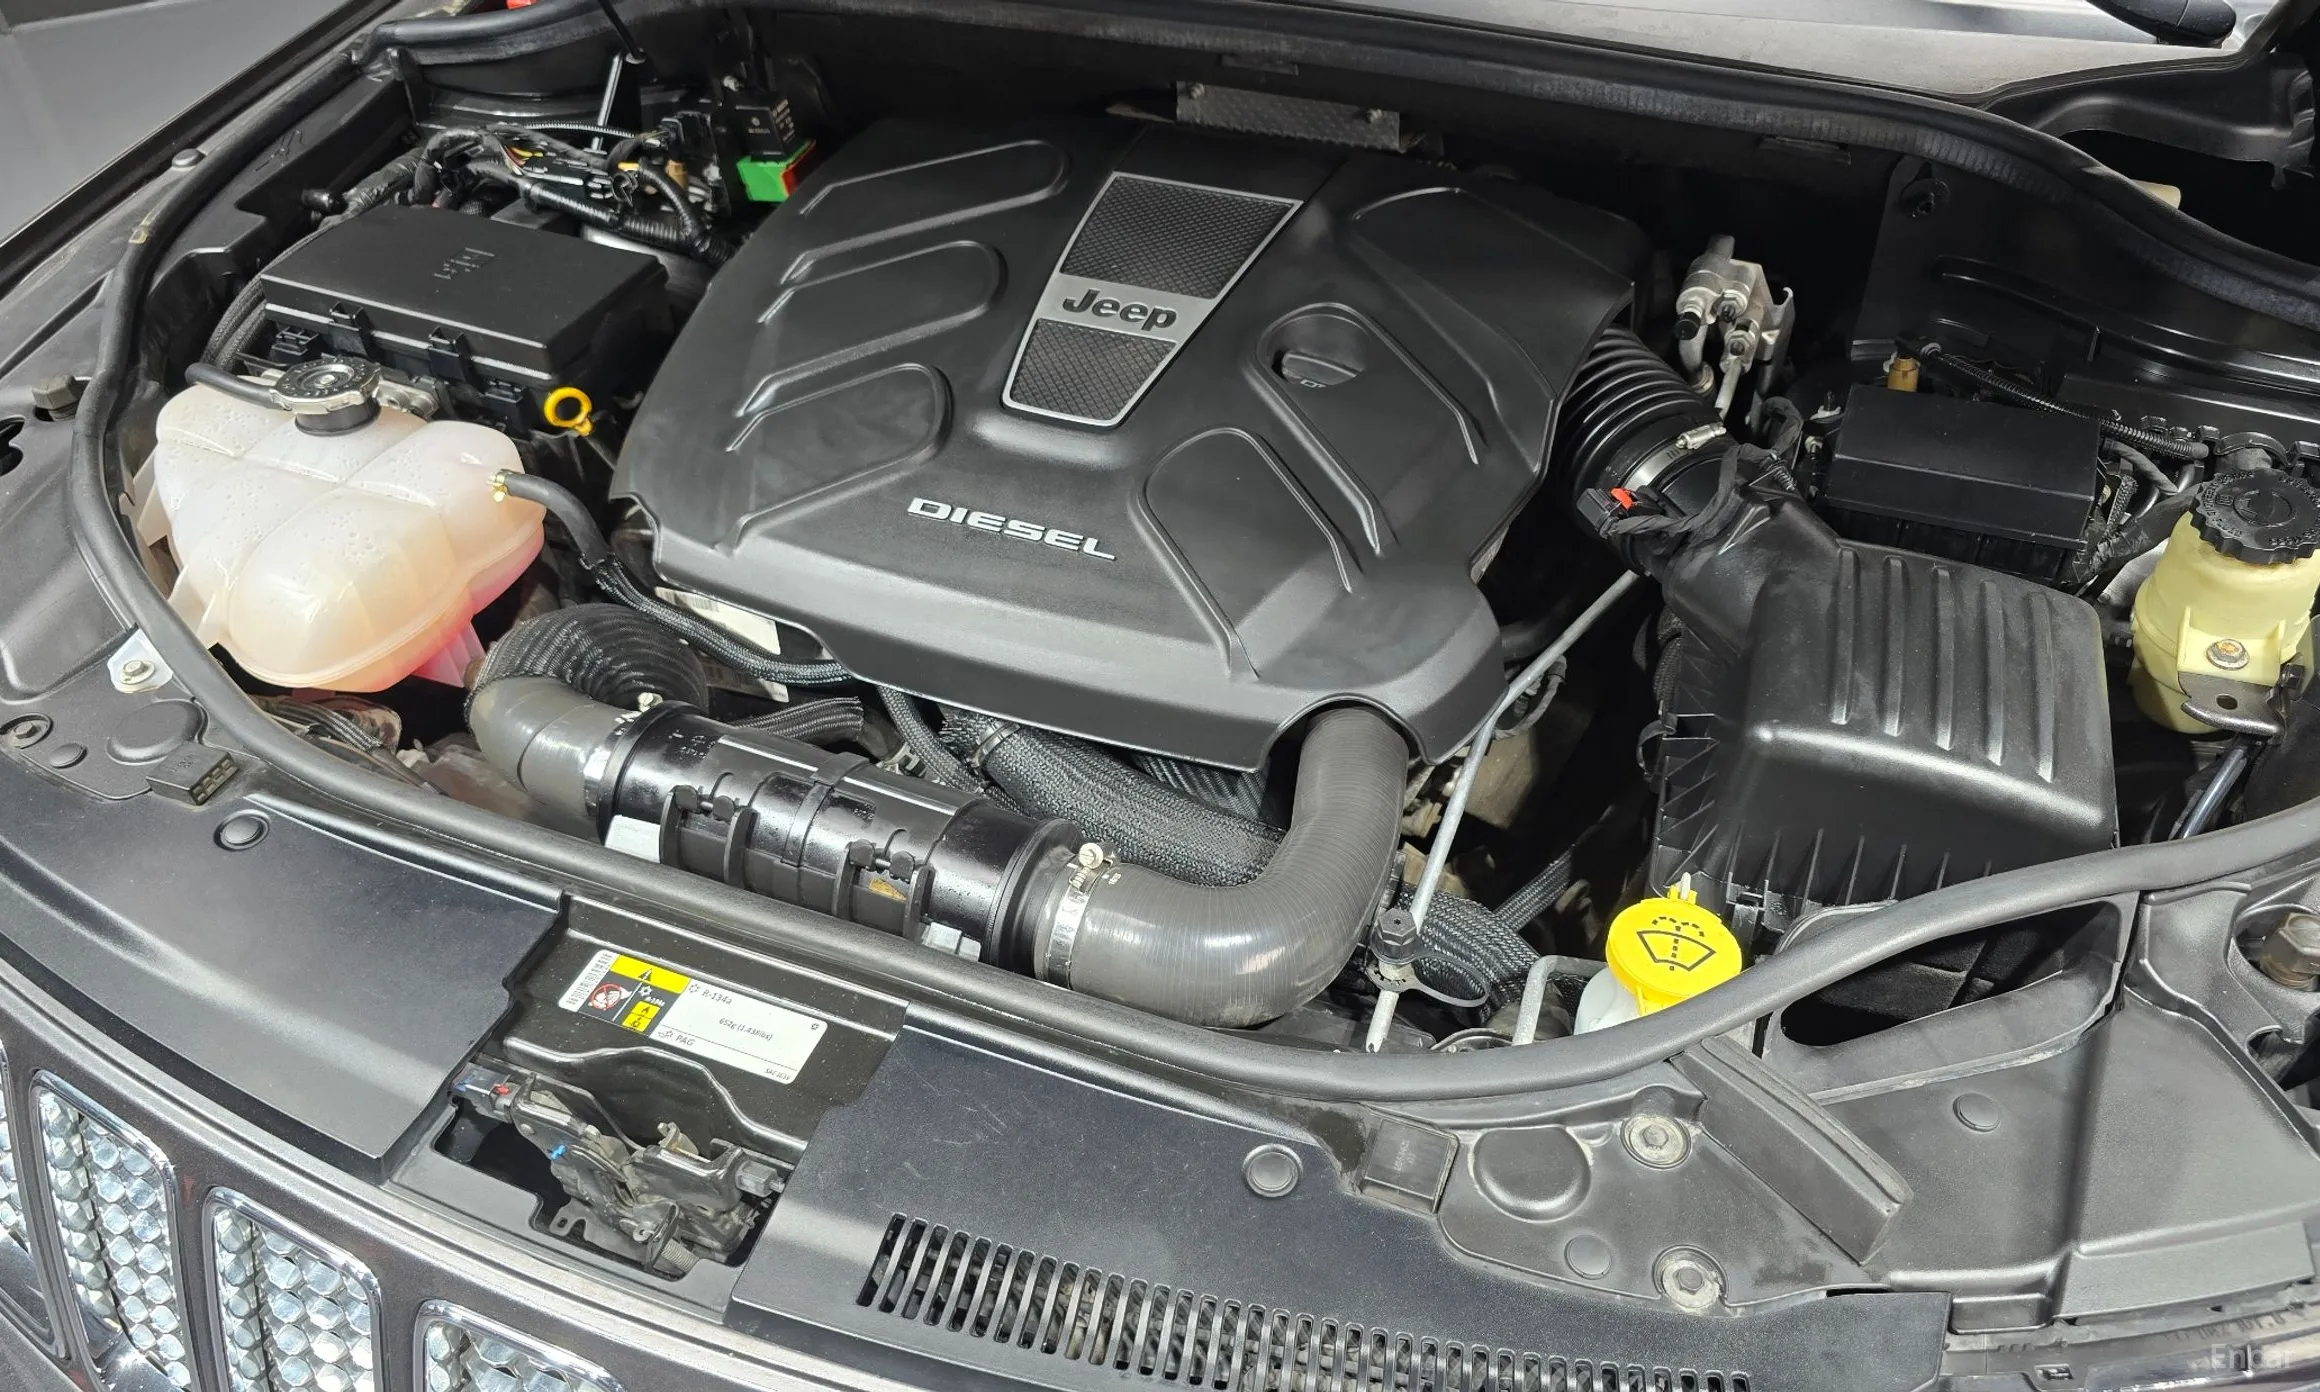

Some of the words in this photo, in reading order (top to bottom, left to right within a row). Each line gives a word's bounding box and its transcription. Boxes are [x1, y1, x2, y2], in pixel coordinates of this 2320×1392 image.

[1062, 288, 1177, 331] Jeep
[907, 498, 1117, 561] DIESEL
[702, 989, 732, 1005] R-134a
[675, 1033, 694, 1047] PAG
